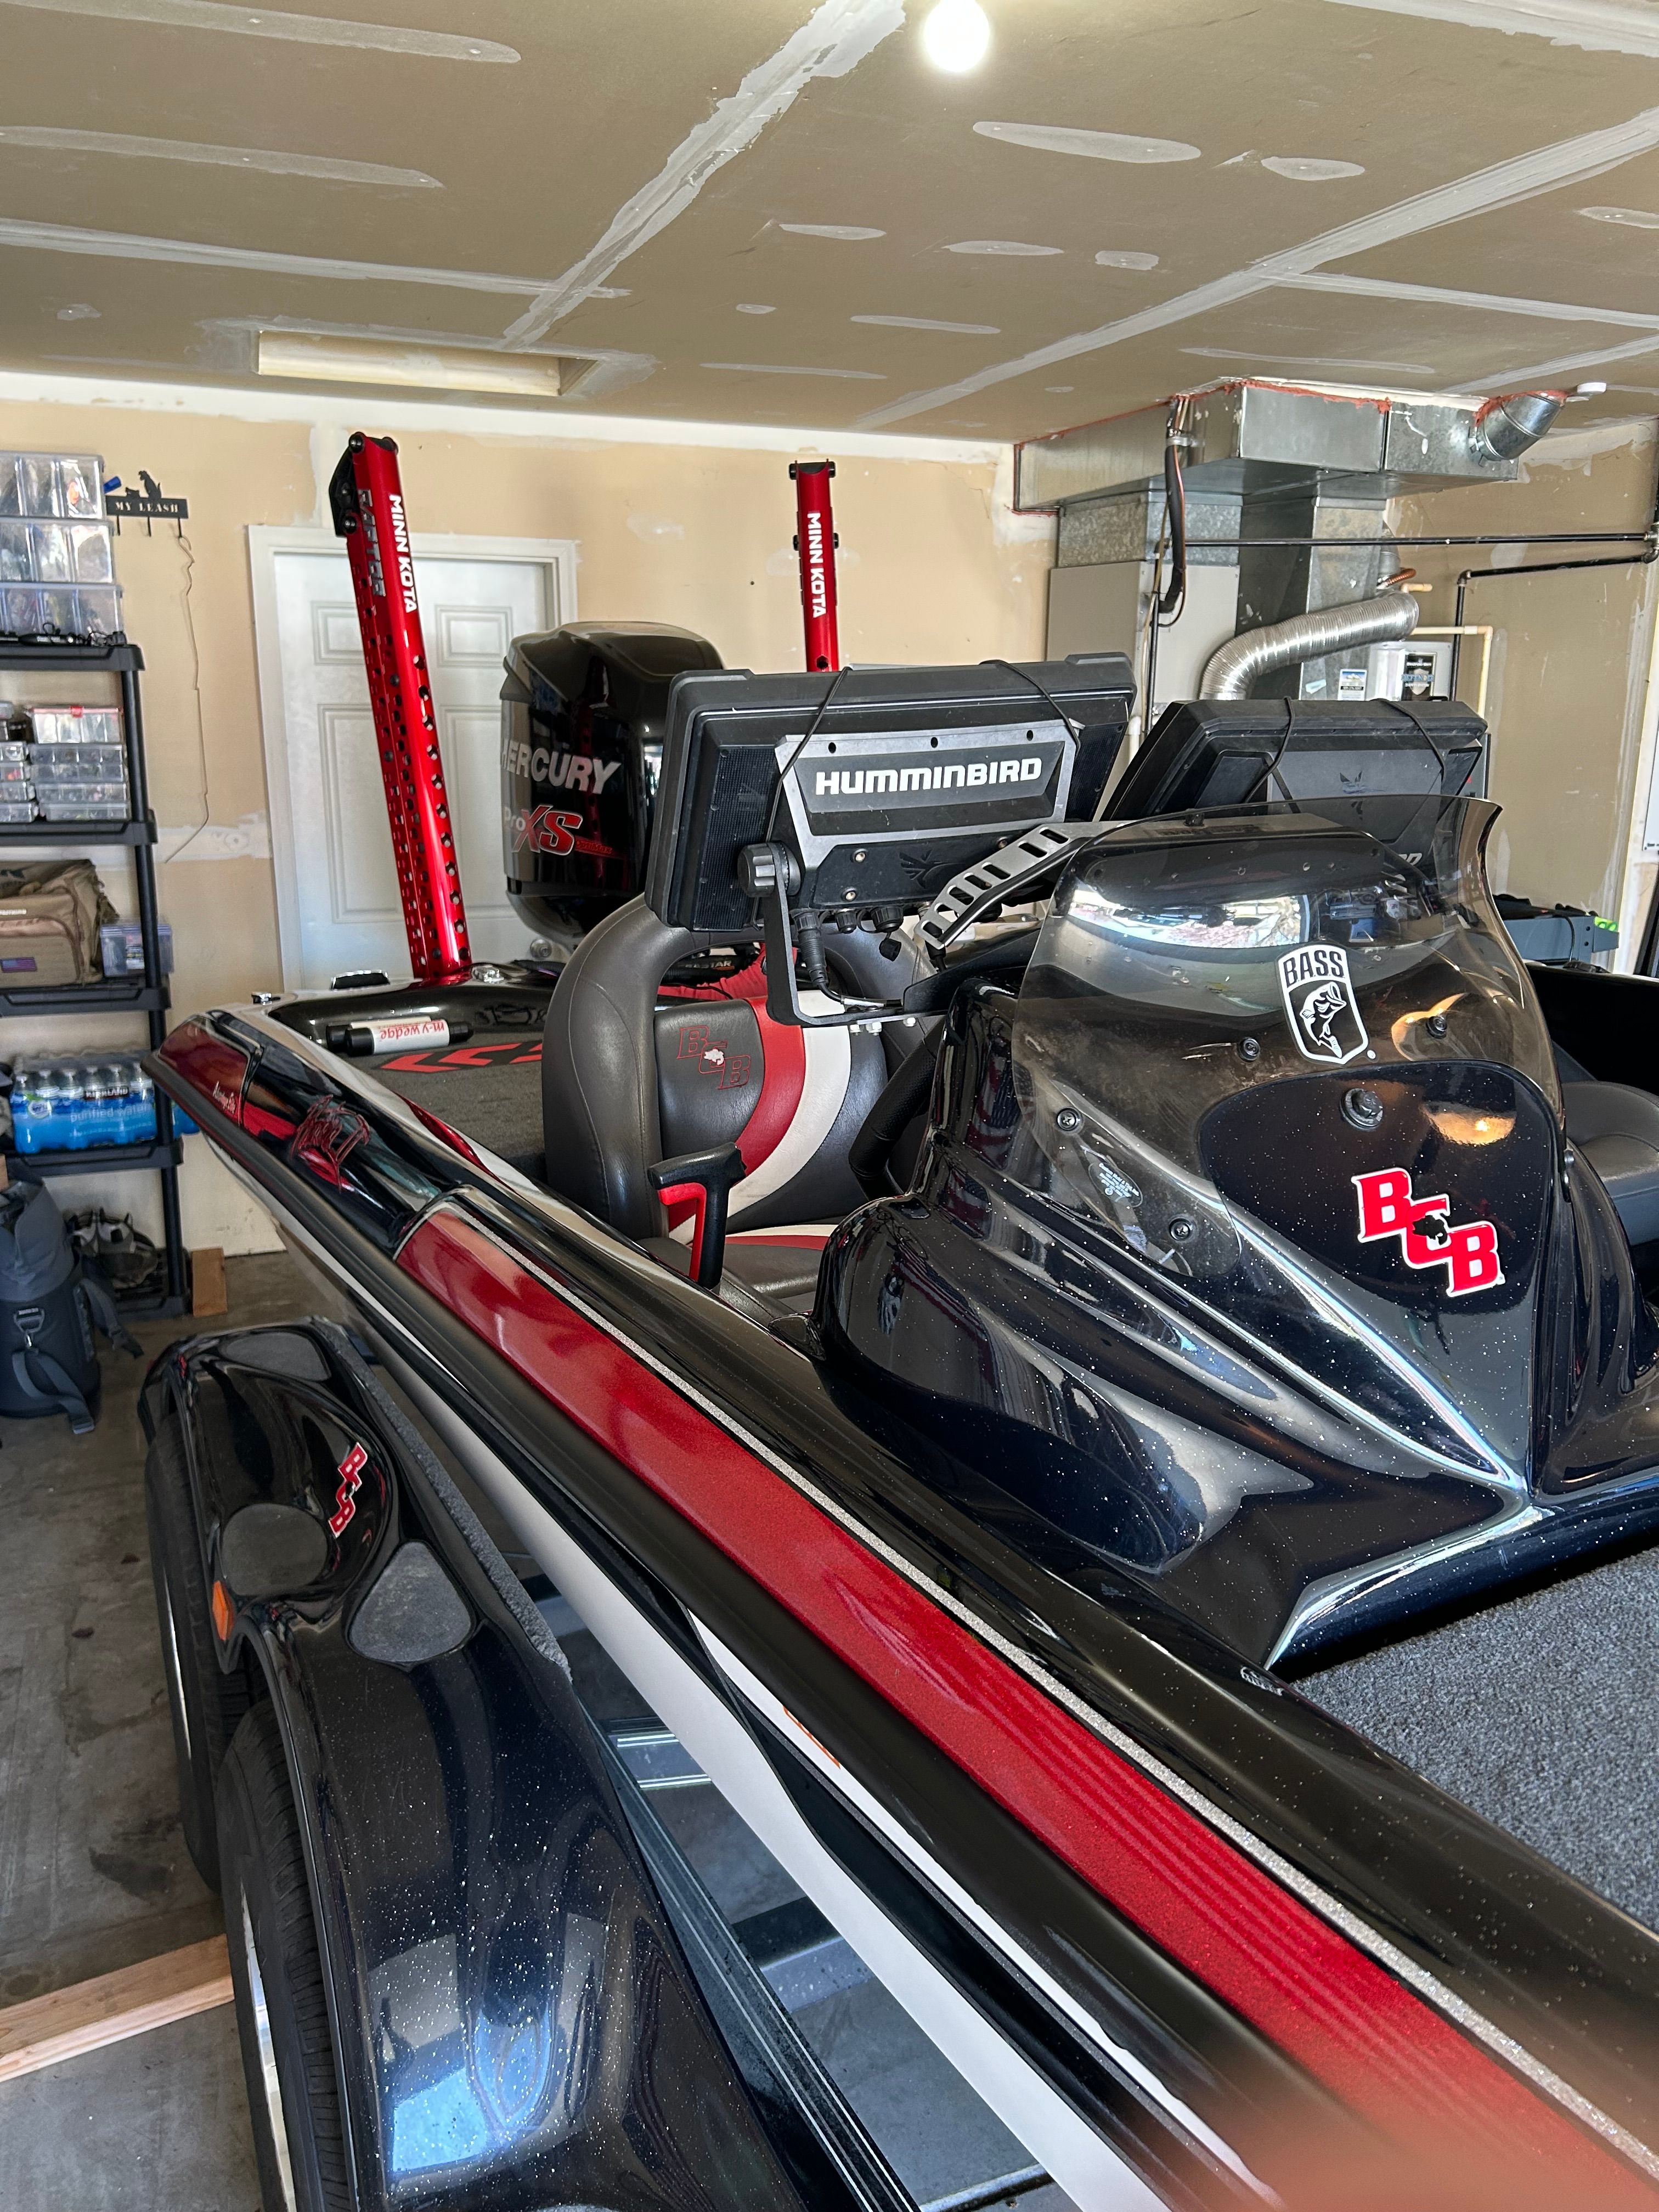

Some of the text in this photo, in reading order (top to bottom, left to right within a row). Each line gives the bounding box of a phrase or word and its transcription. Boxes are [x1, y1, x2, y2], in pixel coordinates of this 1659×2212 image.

[115, 501, 178, 513] MY LEASH
[358, 489, 386, 597] RAPTOR
[389, 494, 417, 613] MINN KOTA
[807, 512, 827, 618] MINN KOTA
[815, 757, 1042, 795] HUMMINBIRD
[380, 1025, 420, 1040] wedge
[70, 1106, 114, 1122] purified
